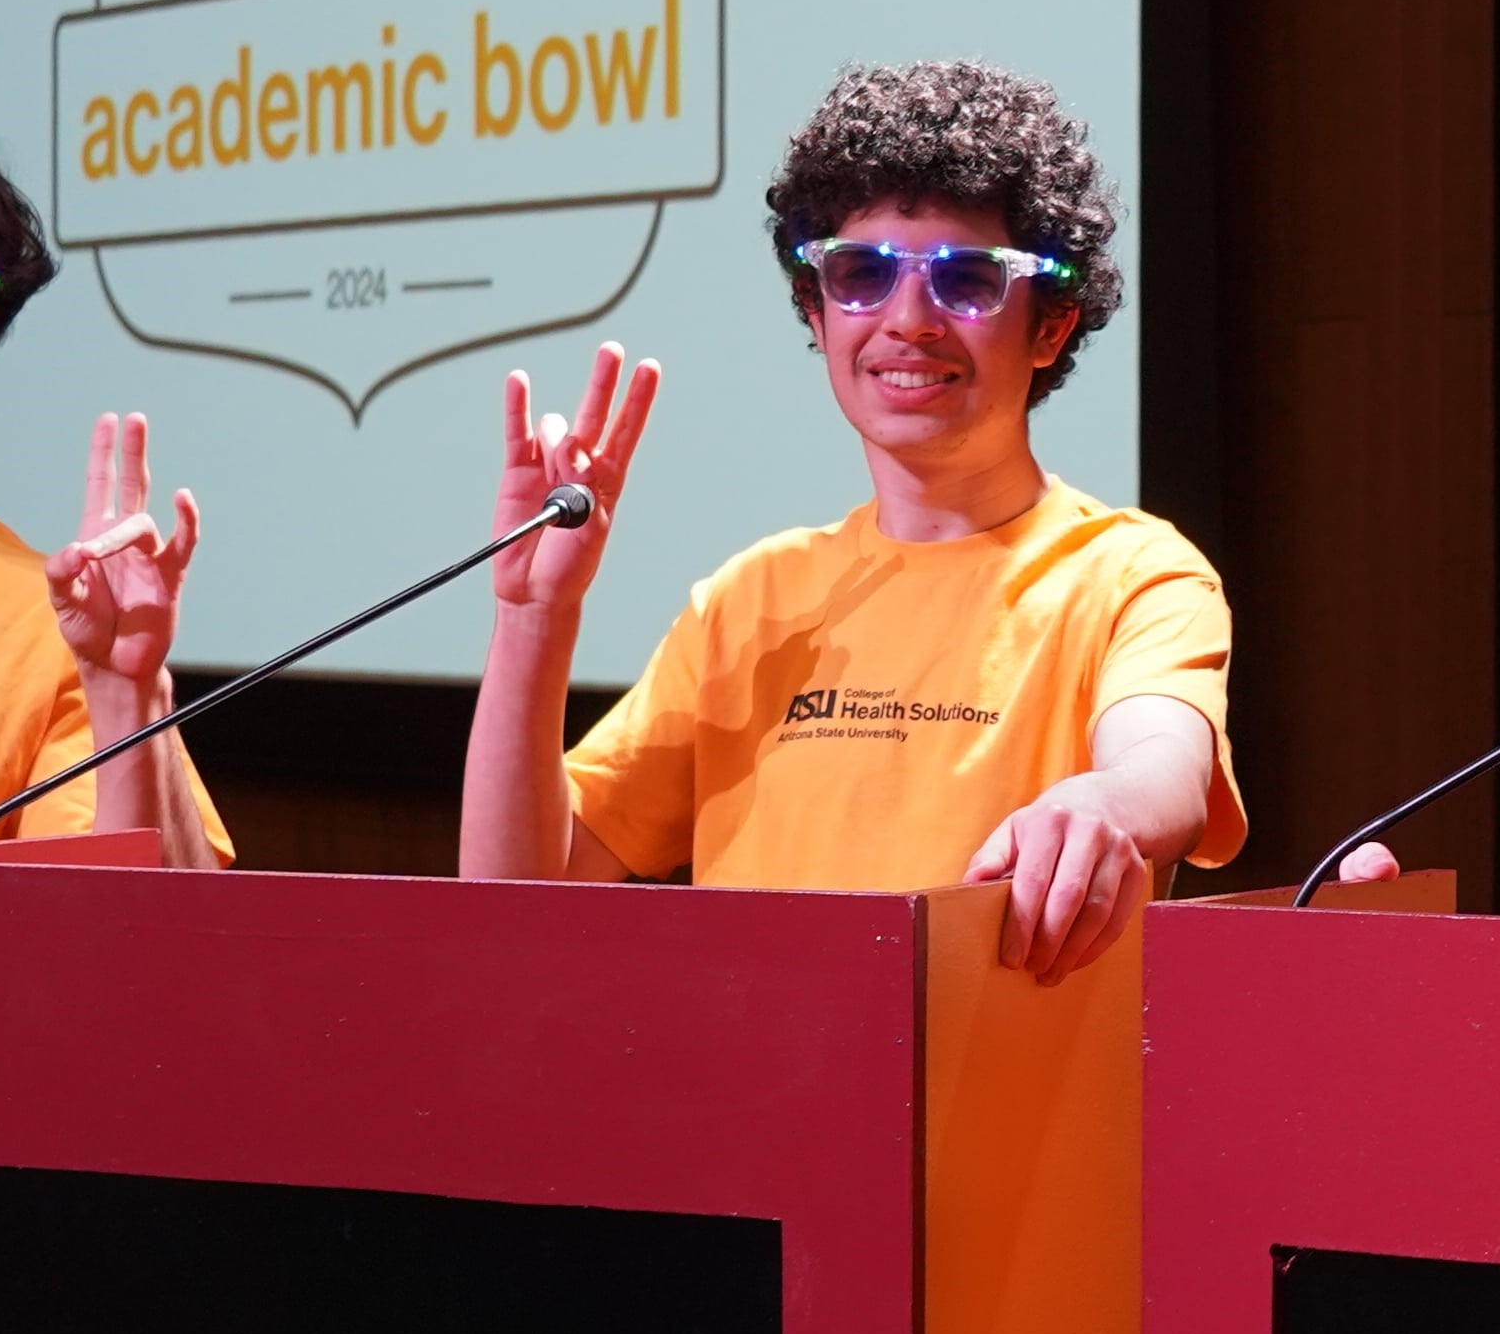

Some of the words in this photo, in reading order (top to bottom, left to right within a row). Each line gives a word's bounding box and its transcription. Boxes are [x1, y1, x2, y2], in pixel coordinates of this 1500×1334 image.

[80, 23, 449, 182] academic
[326, 269, 387, 309] 2024
[784, 689, 837, 725] ASU
[844, 688, 884, 700] College
[886, 688, 896, 698] of
[840, 701, 905, 720] Health
[909, 702, 1000, 725] Solutions
[778, 730, 813, 743] Arizona
[815, 726, 845, 739] State
[848, 727, 908, 743] University
